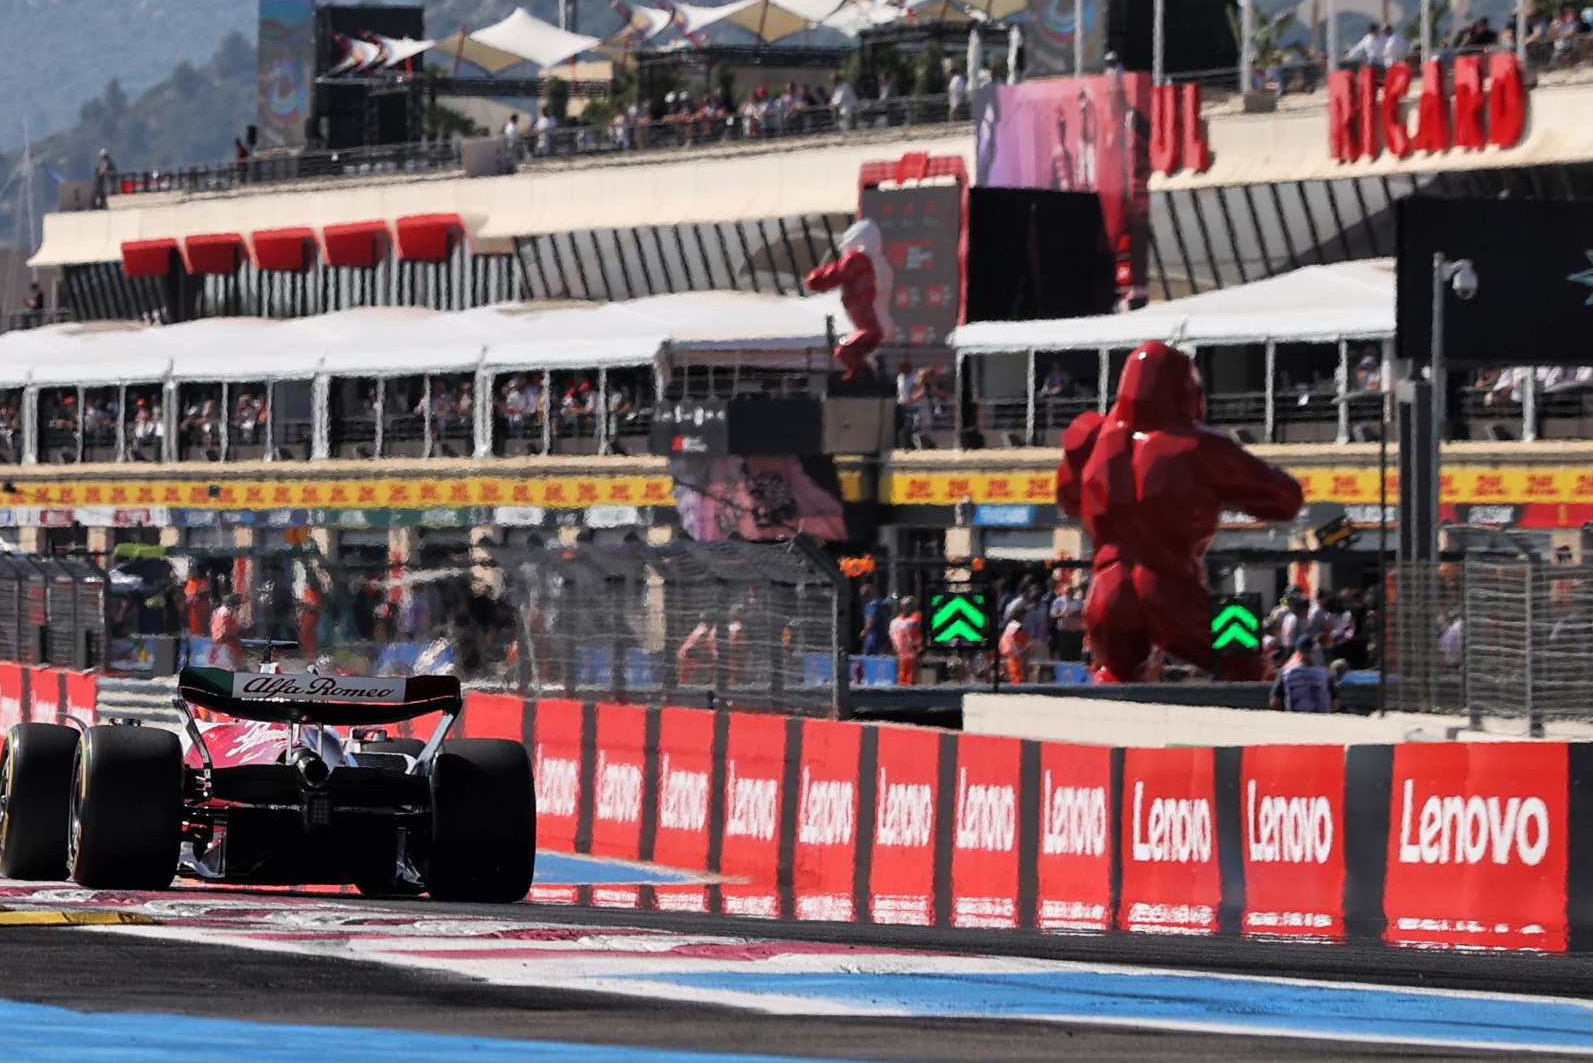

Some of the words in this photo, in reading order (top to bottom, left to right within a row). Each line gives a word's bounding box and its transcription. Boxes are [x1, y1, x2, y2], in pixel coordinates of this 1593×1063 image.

[1149, 83, 1208, 173] UL
[1328, 52, 1525, 162] RICARD
[243, 676, 305, 698] Alfa
[301, 677, 396, 698] Romeo
[1132, 779, 1212, 864] Lenovo
[1247, 778, 1333, 864] Lenovo
[1398, 778, 1550, 866] Lenovo
